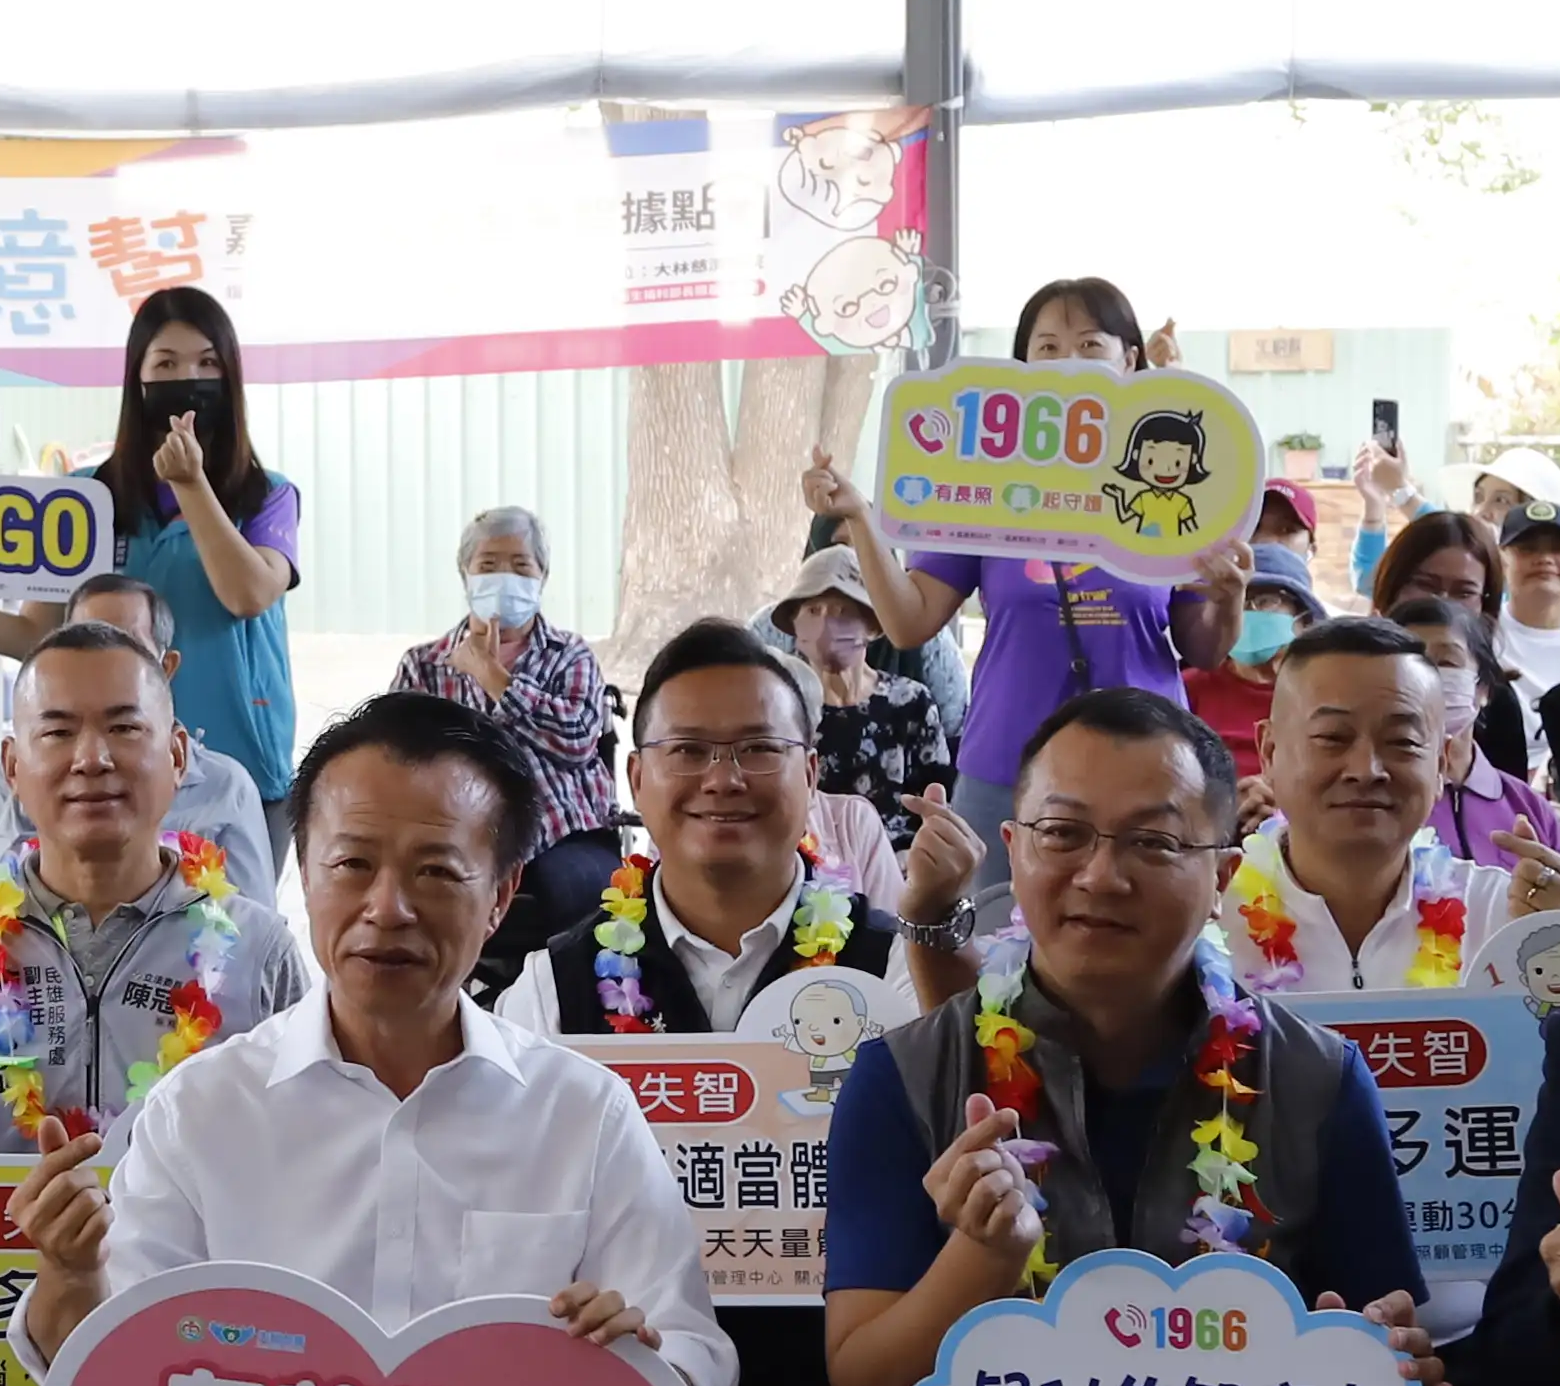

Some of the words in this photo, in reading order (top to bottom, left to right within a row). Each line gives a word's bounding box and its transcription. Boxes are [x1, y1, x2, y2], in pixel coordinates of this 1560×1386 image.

[955, 388, 1105, 465] 1966
[44, 966, 67, 1066] 民雄服務處
[1360, 1029, 1471, 1078] 失智
[623, 1070, 739, 1116] 失智
[705, 1228, 827, 1259] 天天量
[703, 1268, 783, 1286] 管理中心
[1149, 1305, 1248, 1352] 1966
